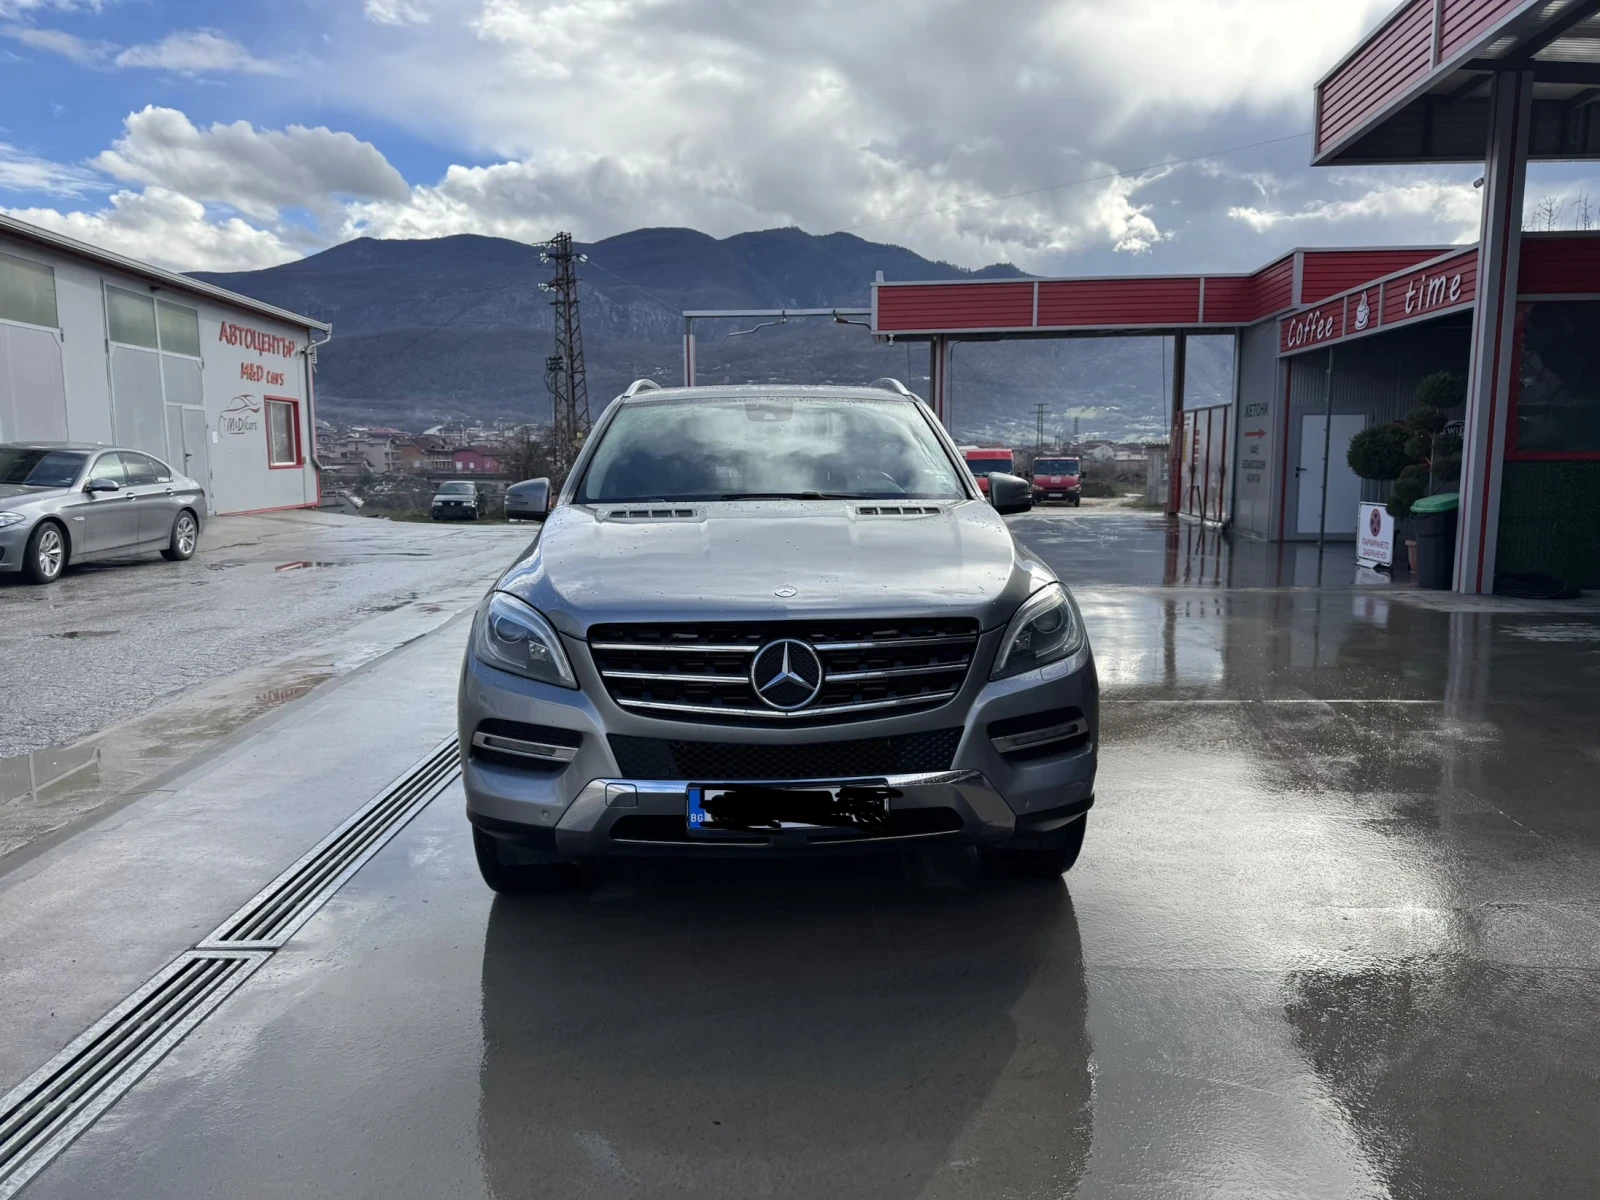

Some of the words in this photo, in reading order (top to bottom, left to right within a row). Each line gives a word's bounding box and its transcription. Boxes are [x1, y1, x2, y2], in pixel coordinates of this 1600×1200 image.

[1288, 310, 1333, 347] Coffee
[1405, 273, 1462, 314] time
[219, 321, 296, 358] АВТОЦЕНТЪР
[240, 362, 264, 382] M&D
[266, 370, 285, 386] cars
[1244, 402, 1268, 418] ЖЕТОНИ
[691, 814, 703, 822] BG
